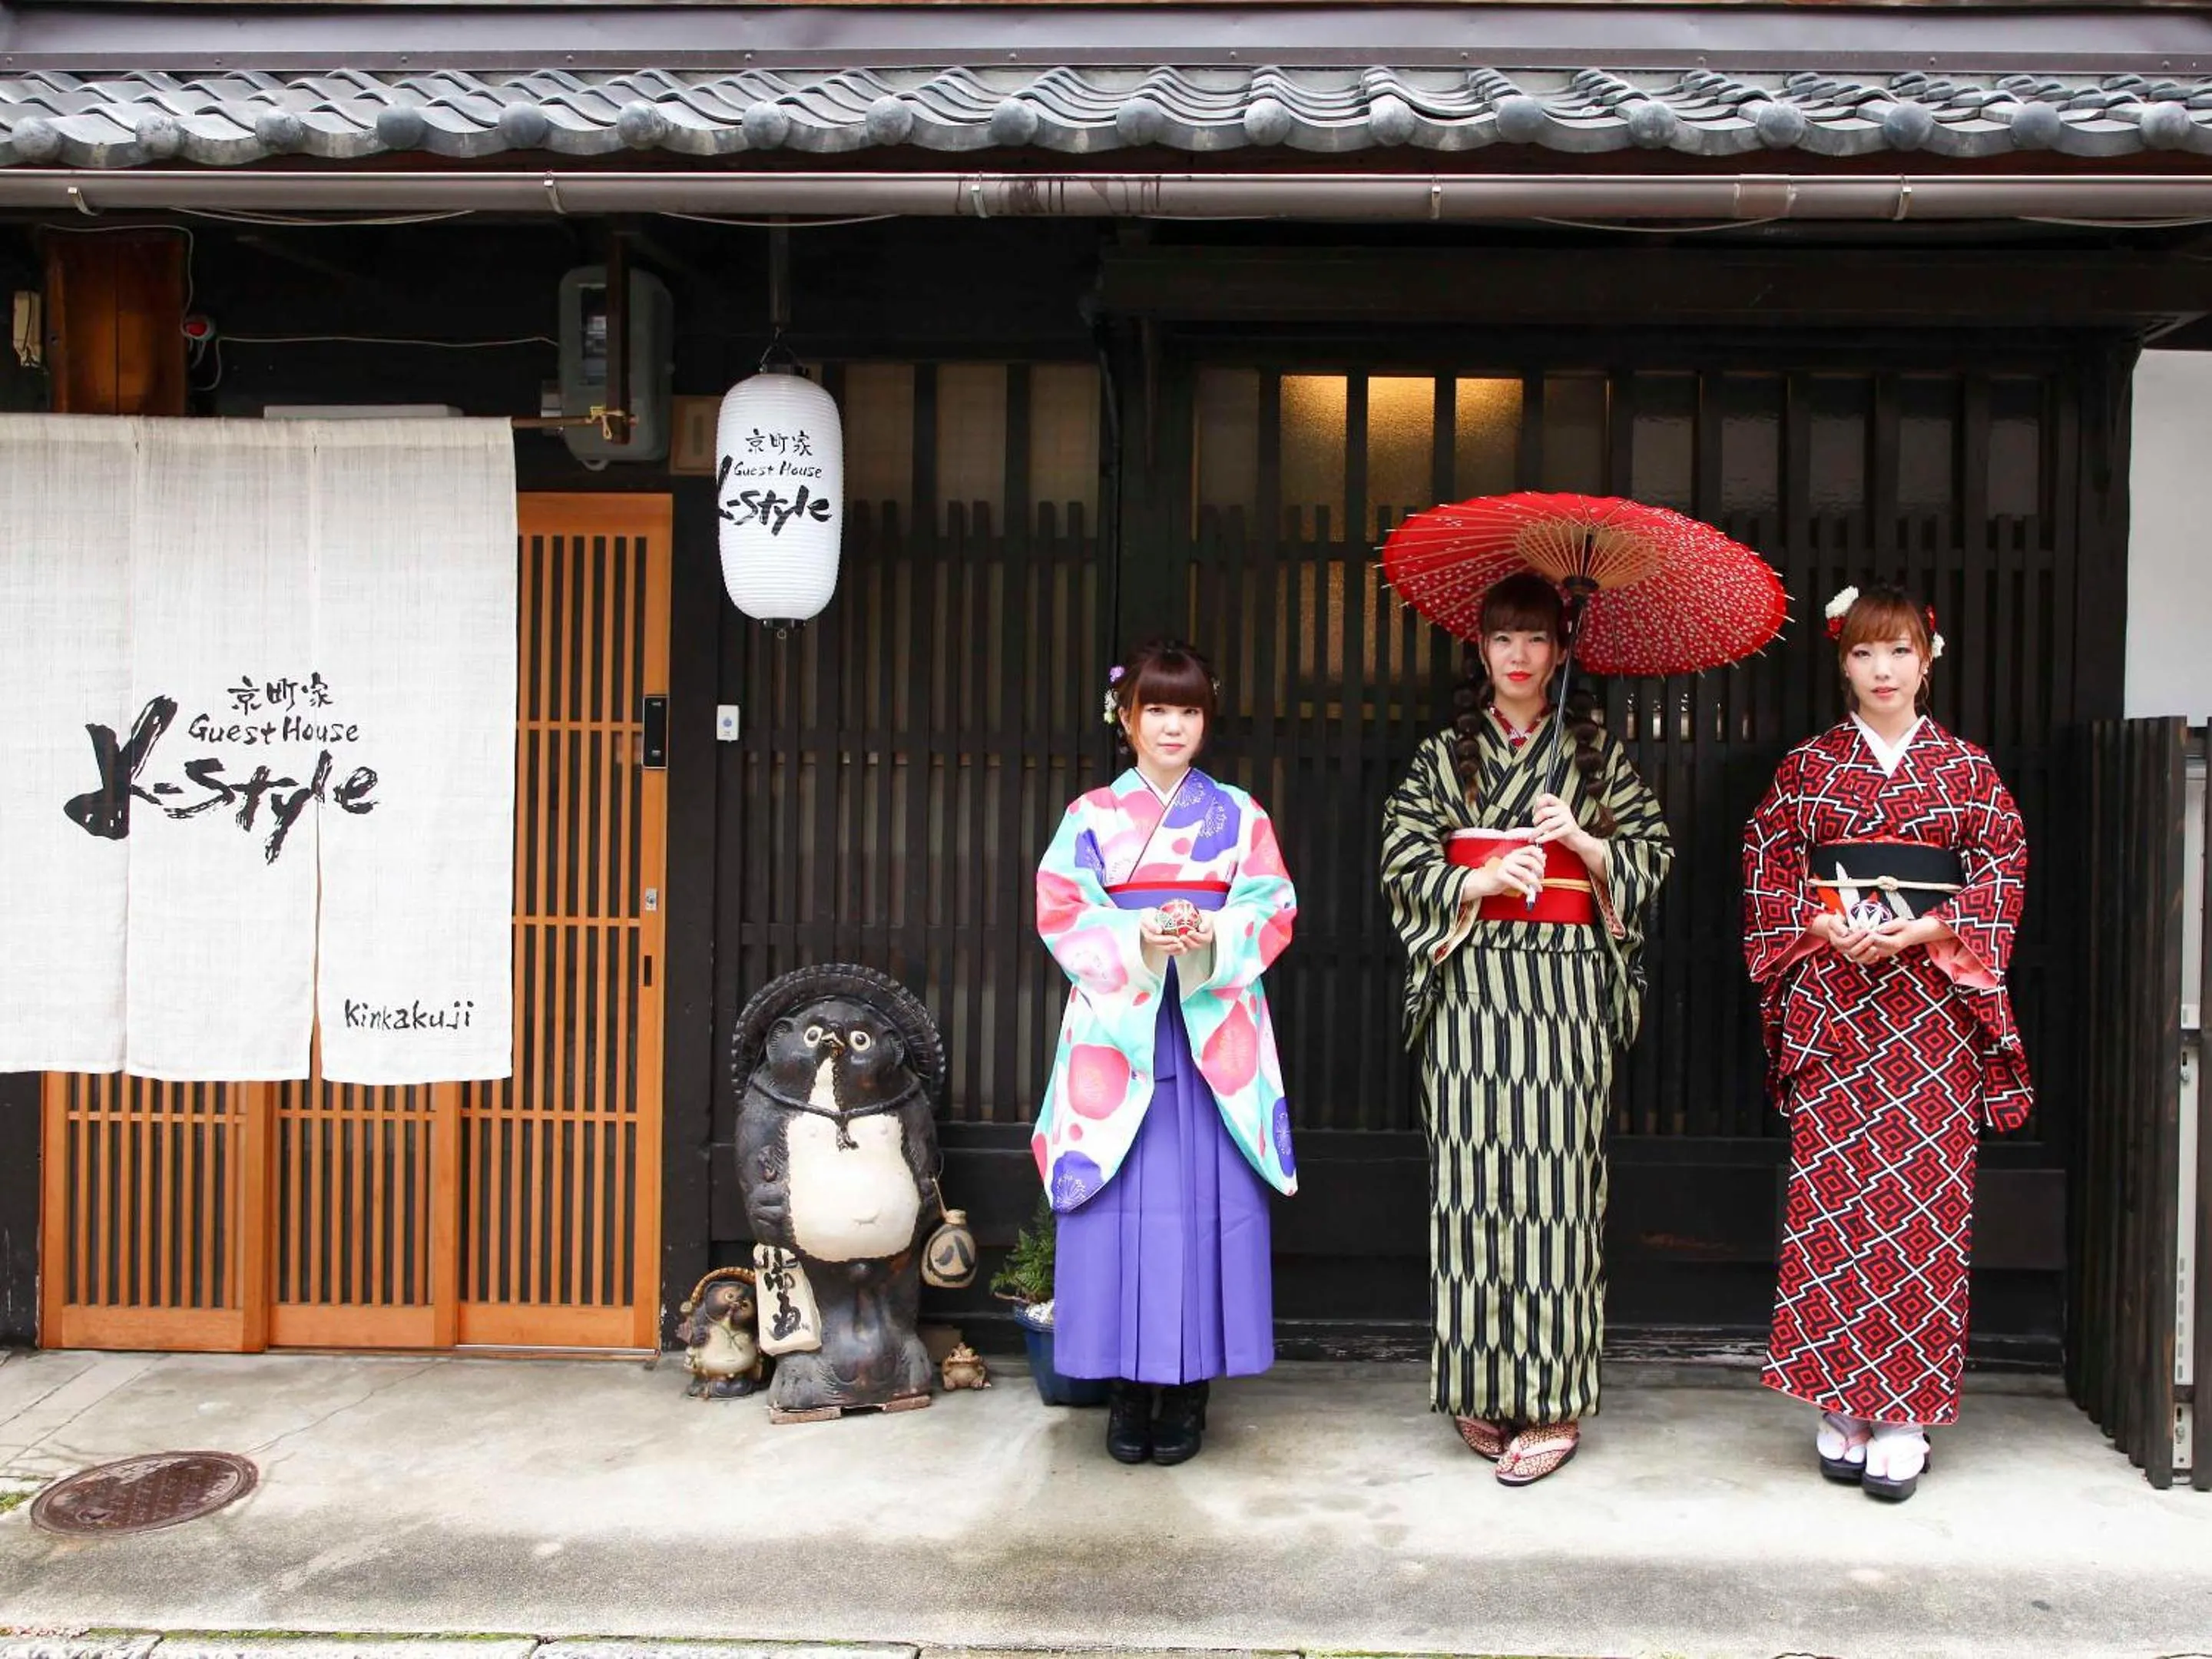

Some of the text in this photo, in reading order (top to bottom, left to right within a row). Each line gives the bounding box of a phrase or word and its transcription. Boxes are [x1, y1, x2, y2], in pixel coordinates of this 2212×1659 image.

[745, 427, 813, 457] 京町家
[733, 460, 823, 478] Guest House
[227, 671, 333, 716] 京町家
[187, 713, 359, 746] Guest House
[343, 998, 475, 1031] Kinkakuji
